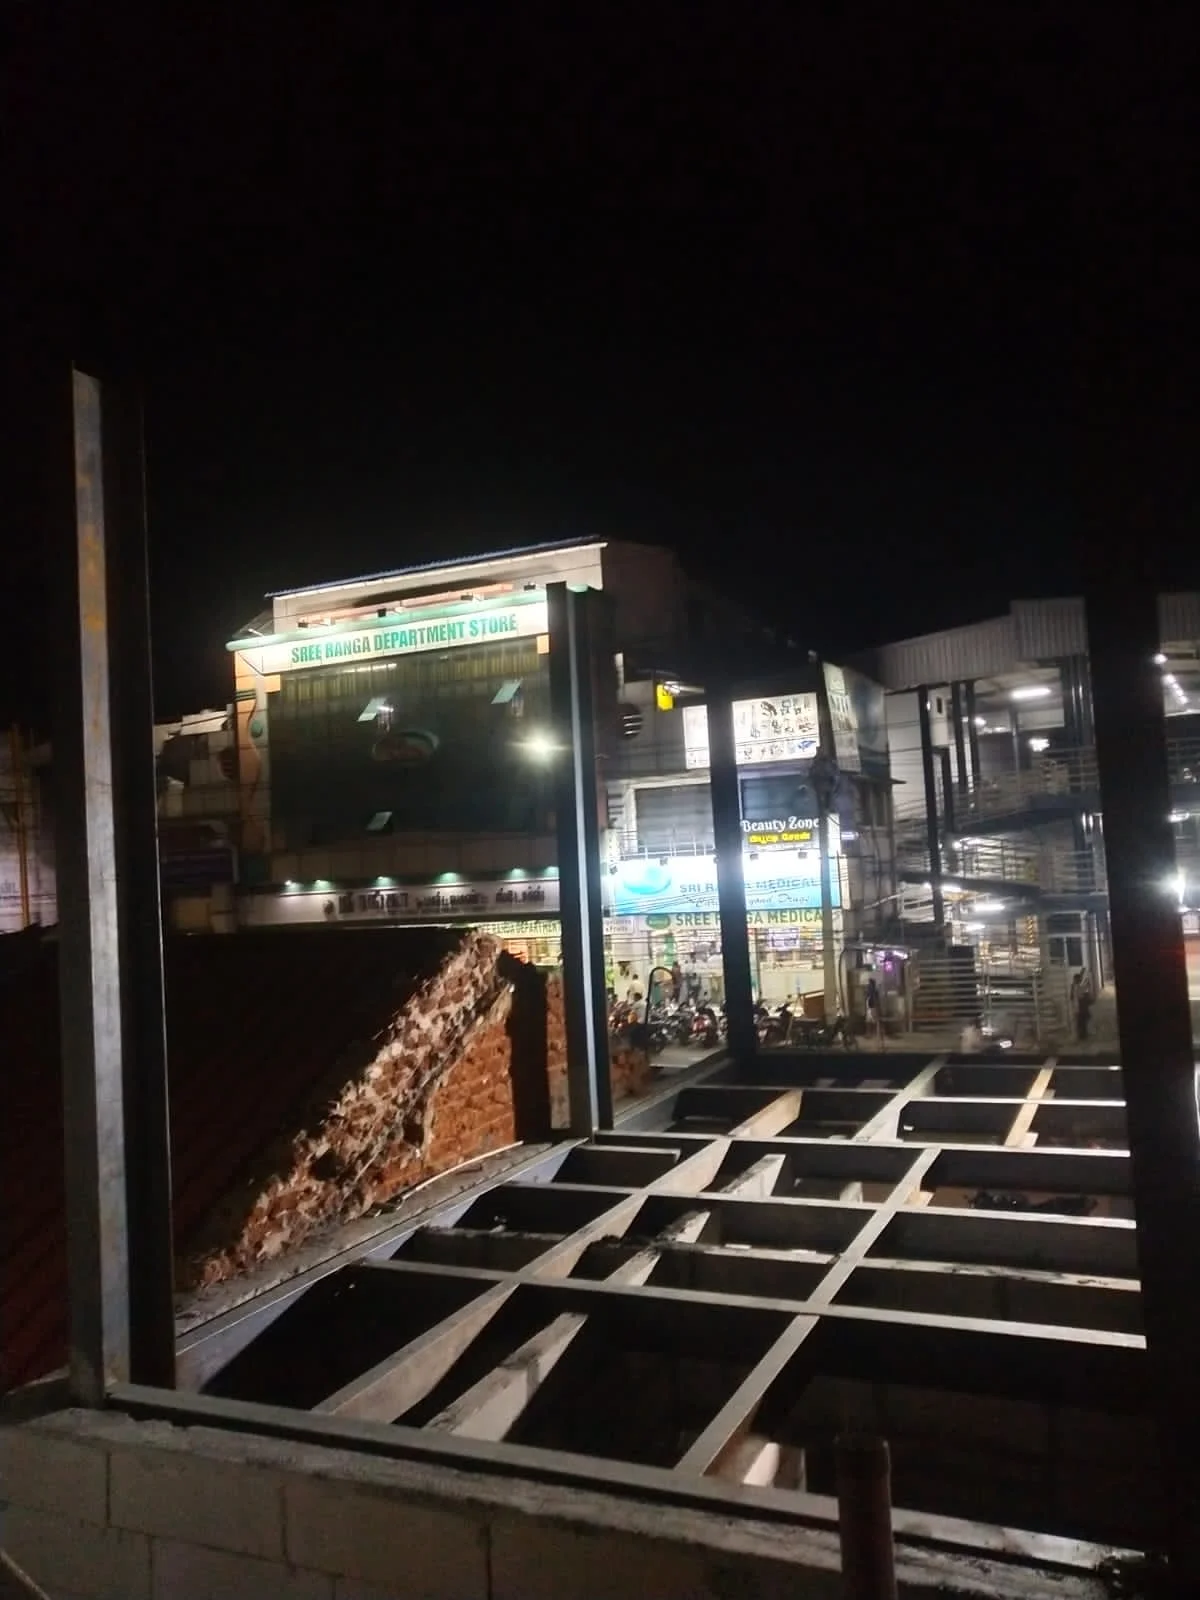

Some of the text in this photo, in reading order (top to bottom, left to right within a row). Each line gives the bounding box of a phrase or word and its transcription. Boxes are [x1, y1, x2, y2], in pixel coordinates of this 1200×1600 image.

[291, 613, 517, 663] SREE RANGA DEPARTMENT STORE
[740, 819, 786, 832] Beauty
[675, 911, 711, 926] SREE
[768, 908, 824, 923] MEDICA
